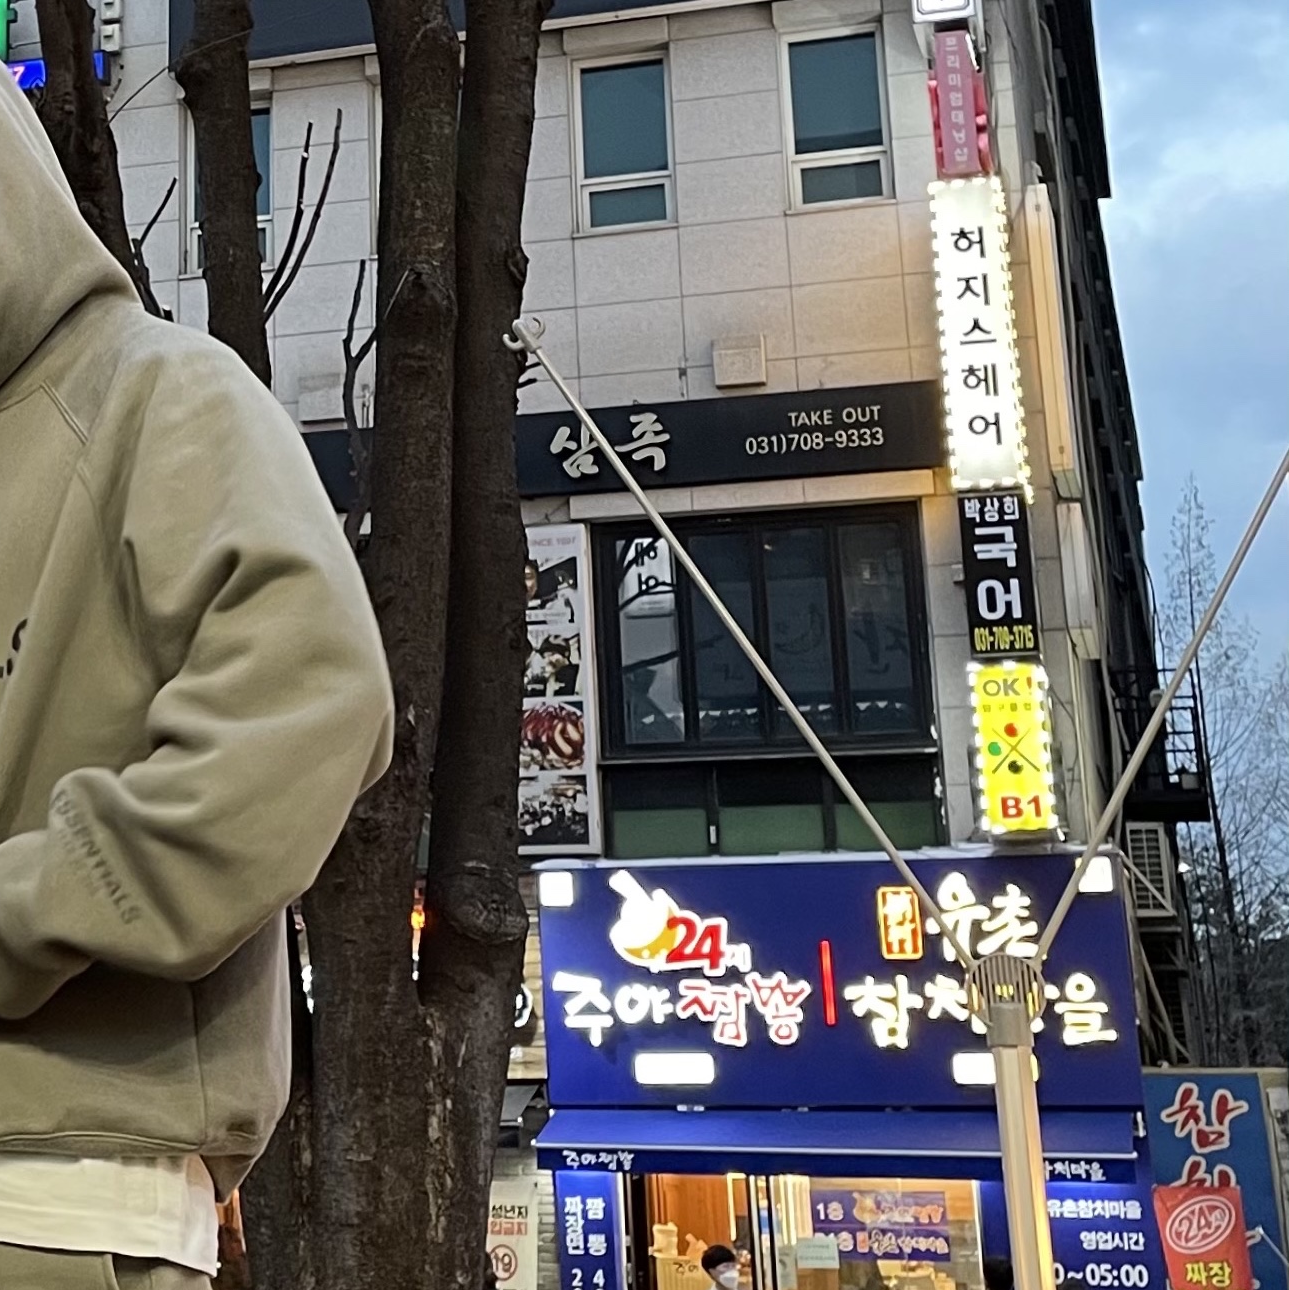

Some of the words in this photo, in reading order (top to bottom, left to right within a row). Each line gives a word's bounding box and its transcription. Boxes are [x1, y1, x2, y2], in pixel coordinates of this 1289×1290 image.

[950, 225, 1002, 446] 허지스헤어
[788, 409, 832, 428] TAKE
[842, 405, 881, 425] OUT
[745, 427, 885, 456] 031)708-9333
[973, 525, 1023, 621] 국어
[1000, 795, 1043, 819] B1
[1079, 1230, 1146, 1252] 영업시간
[1184, 1260, 1232, 1288] 짜장
